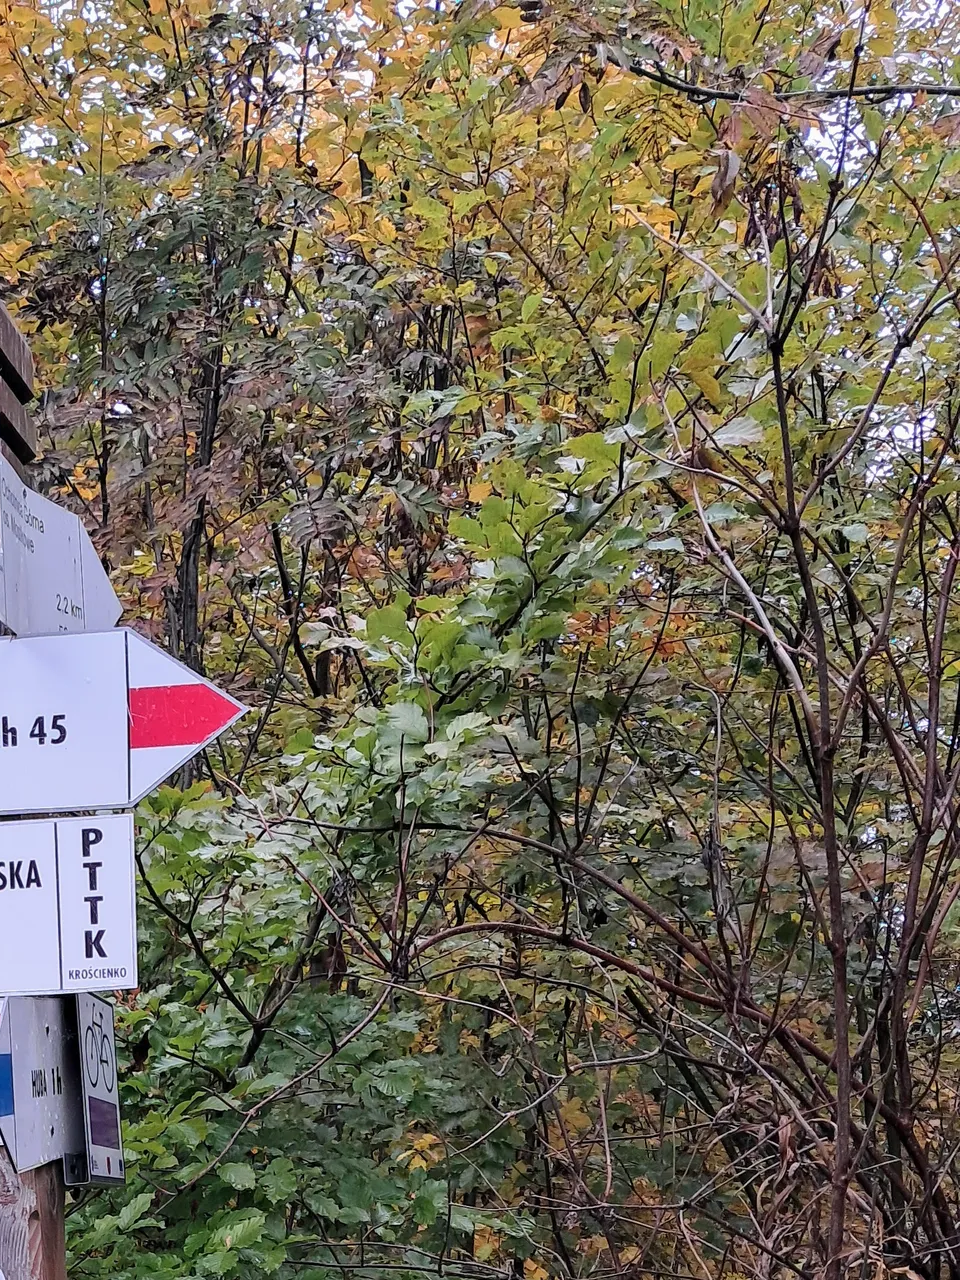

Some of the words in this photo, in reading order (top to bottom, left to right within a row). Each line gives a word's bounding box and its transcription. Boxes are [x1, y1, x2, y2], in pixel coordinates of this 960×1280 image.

[29, 714, 67, 746] 45
[81, 827, 109, 960] PTTK
[67, 965, 128, 981] KROŚCIENKO
